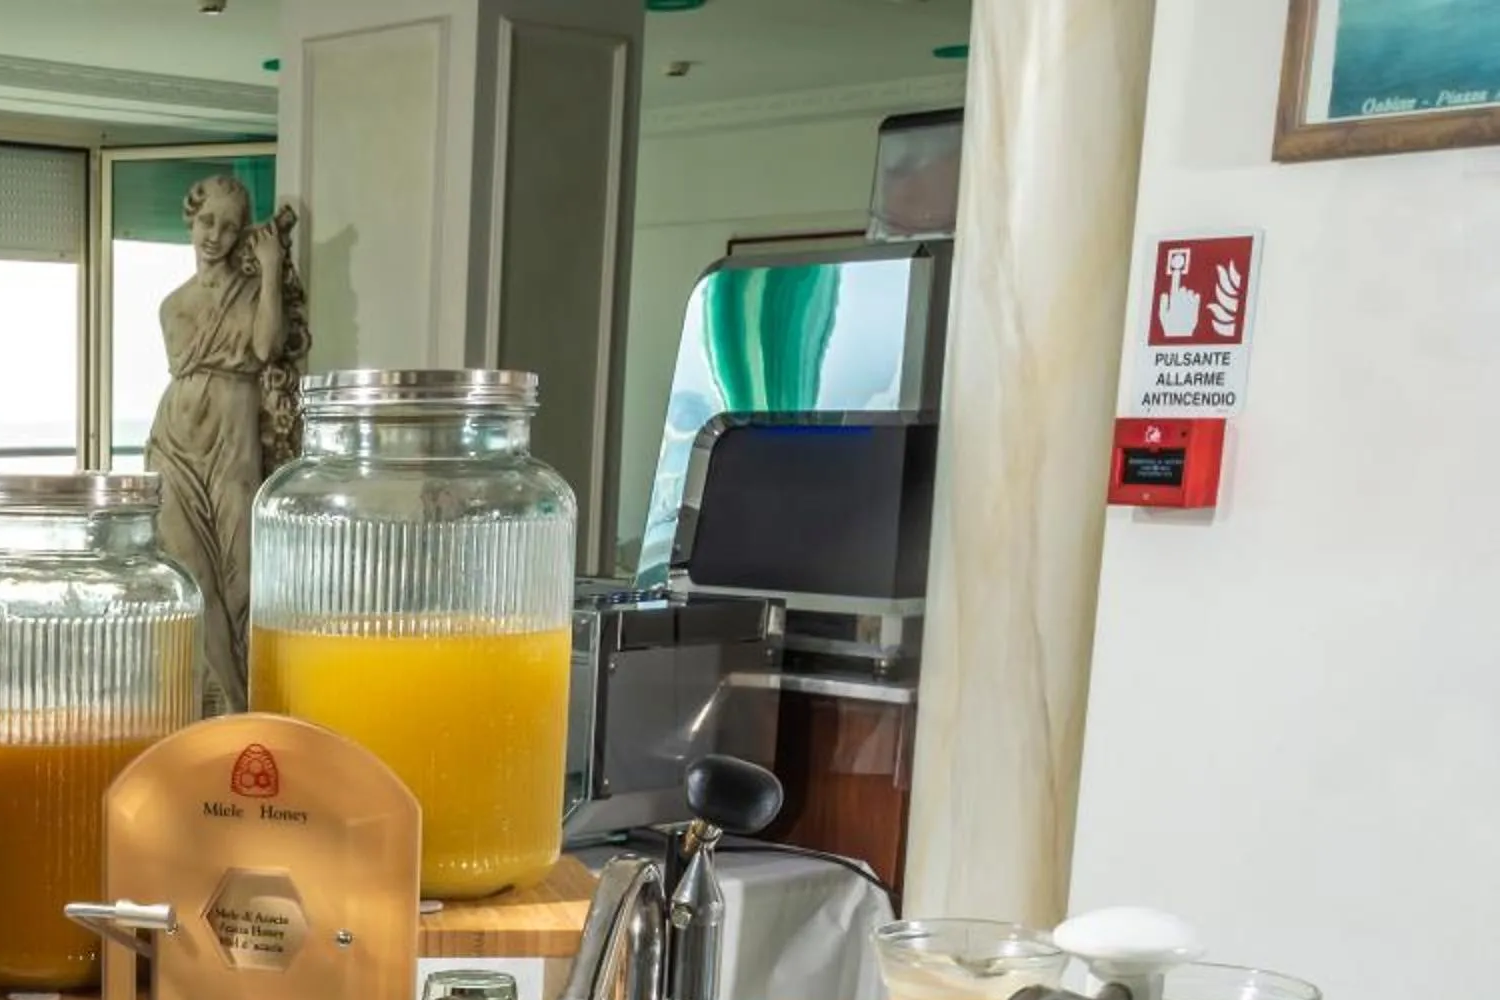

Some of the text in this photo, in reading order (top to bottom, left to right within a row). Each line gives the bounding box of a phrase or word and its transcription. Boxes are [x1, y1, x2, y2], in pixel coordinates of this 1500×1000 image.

[1155, 351, 1231, 367] PULSANTE
[1155, 371, 1226, 387] ALLARME
[1141, 391, 1236, 407] ANTINCENDIO
[203, 802, 308, 825] Miele Honey
